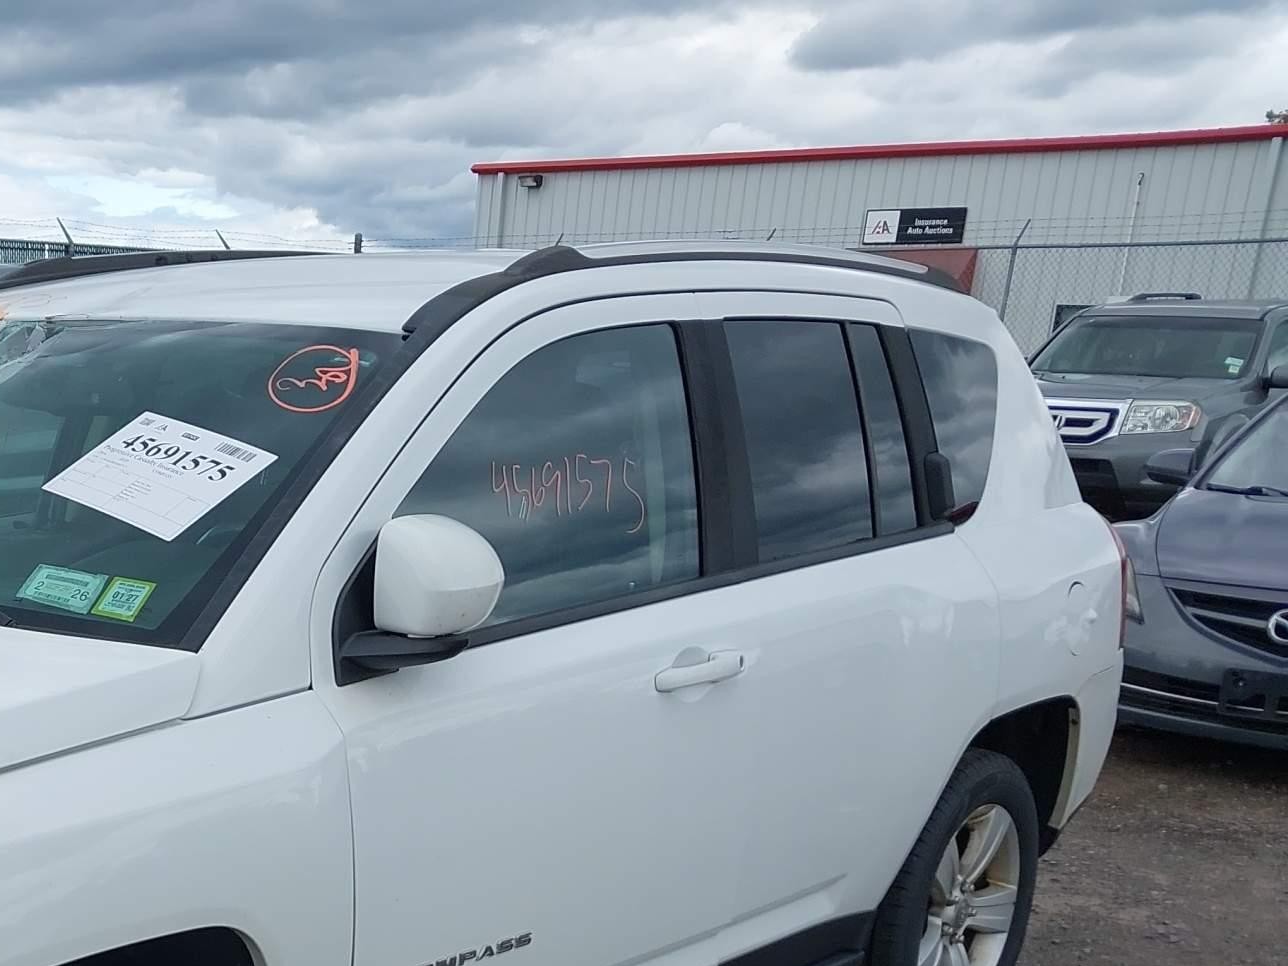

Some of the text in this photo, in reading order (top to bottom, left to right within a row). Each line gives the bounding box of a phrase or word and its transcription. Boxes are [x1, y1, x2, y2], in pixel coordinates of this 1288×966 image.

[914, 217, 949, 226] Insurance
[907, 226, 954, 235] Auto Auctions
[122, 434, 236, 482] 45691575
[492, 453, 645, 534] 45691575
[34, 580, 45, 591] 2
[71, 588, 90, 602] 26
